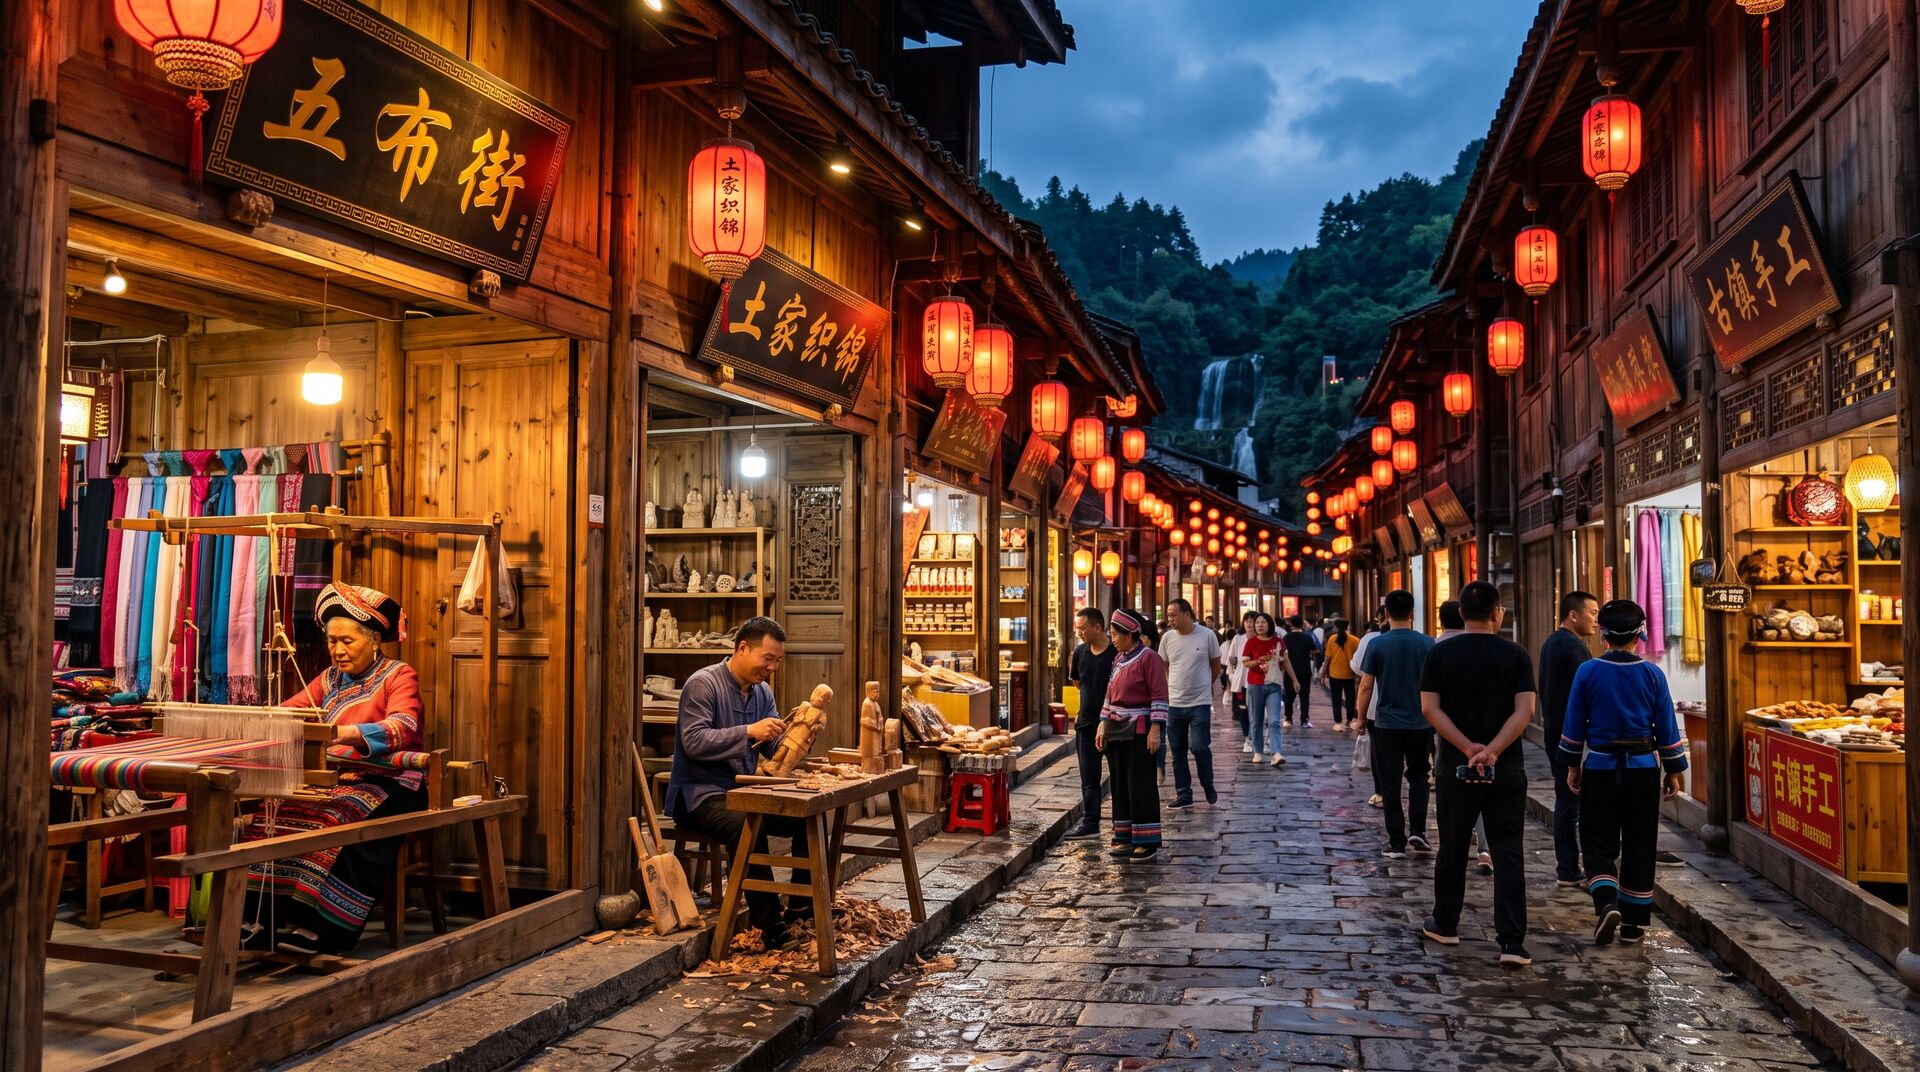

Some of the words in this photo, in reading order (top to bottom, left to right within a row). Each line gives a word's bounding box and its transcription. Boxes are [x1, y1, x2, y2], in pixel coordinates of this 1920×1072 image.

[264, 57, 526, 231] 五布街
[718, 157, 740, 238] 土家织锦
[729, 281, 866, 385] 土家织锦
